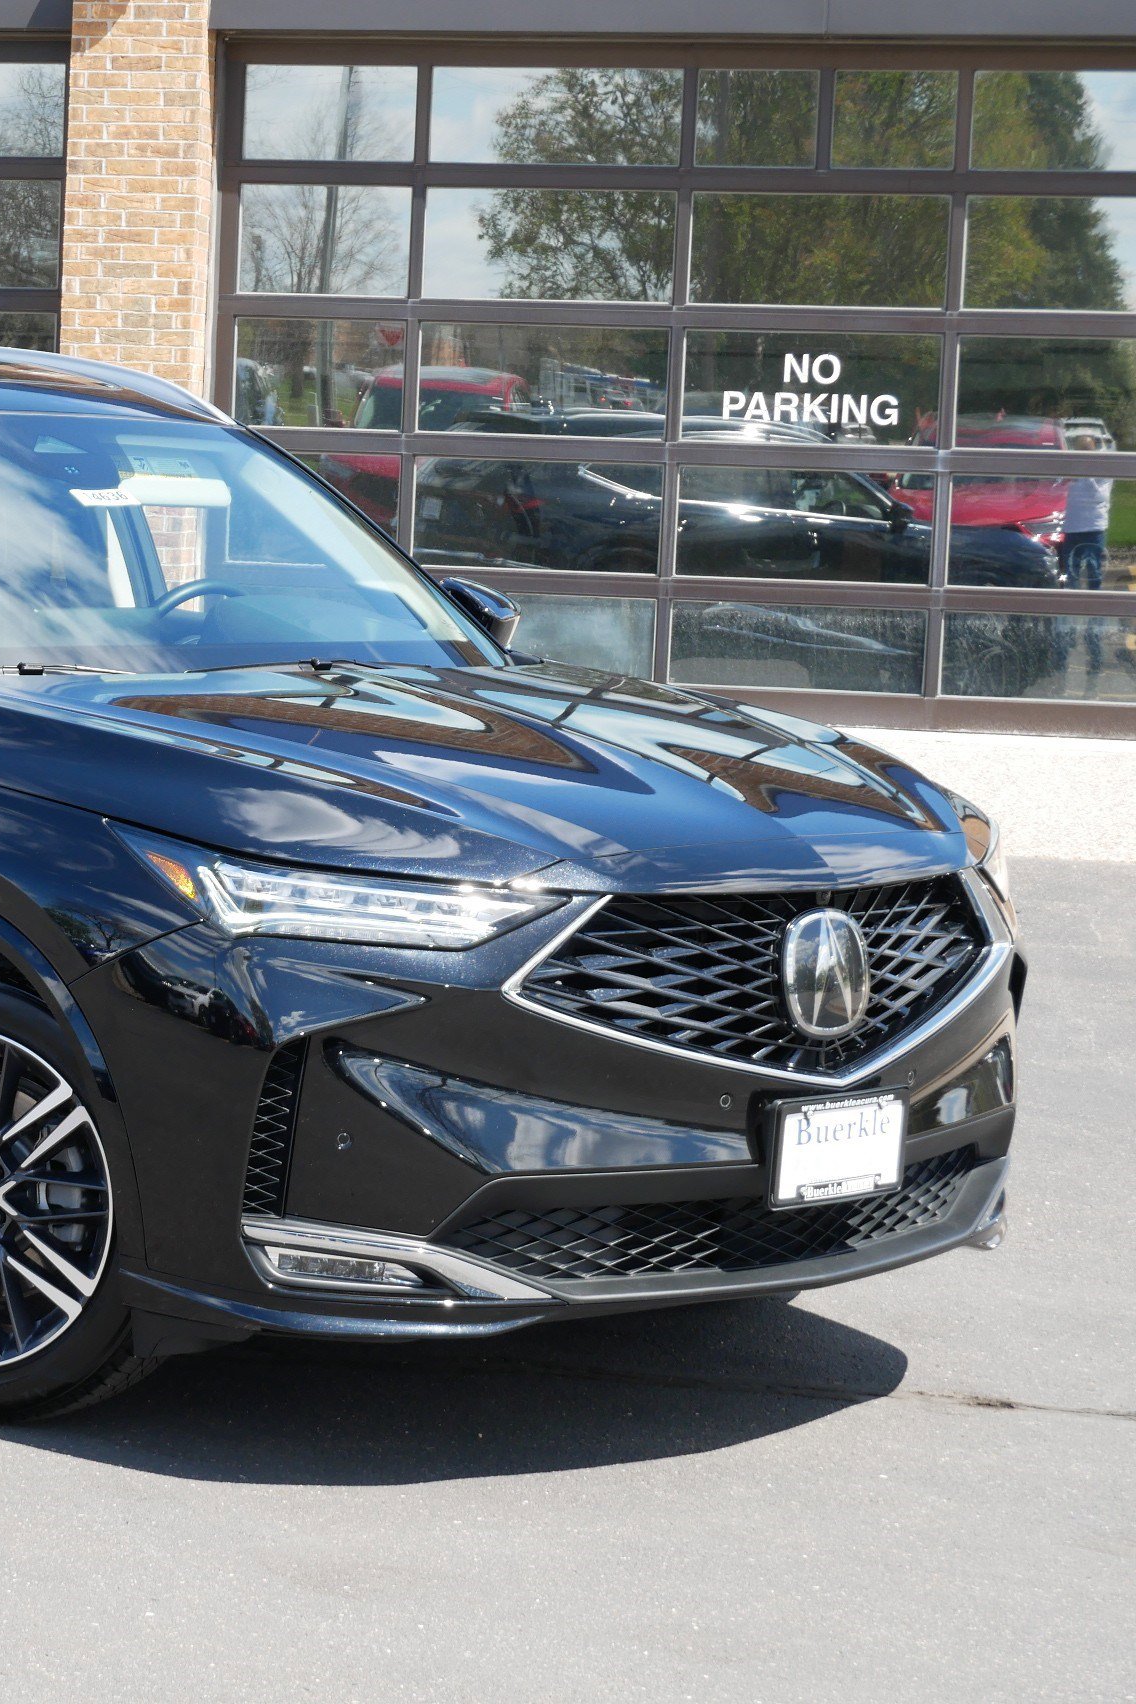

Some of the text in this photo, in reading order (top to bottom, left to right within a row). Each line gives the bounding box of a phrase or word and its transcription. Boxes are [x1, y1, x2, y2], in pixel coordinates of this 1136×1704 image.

[783, 353, 842, 385] NO
[722, 391, 900, 426] PARKING
[82, 491, 129, 502] 14636
[801, 1094, 894, 1112] www.buerkleacura.com
[795, 1109, 890, 1146] Buerkle
